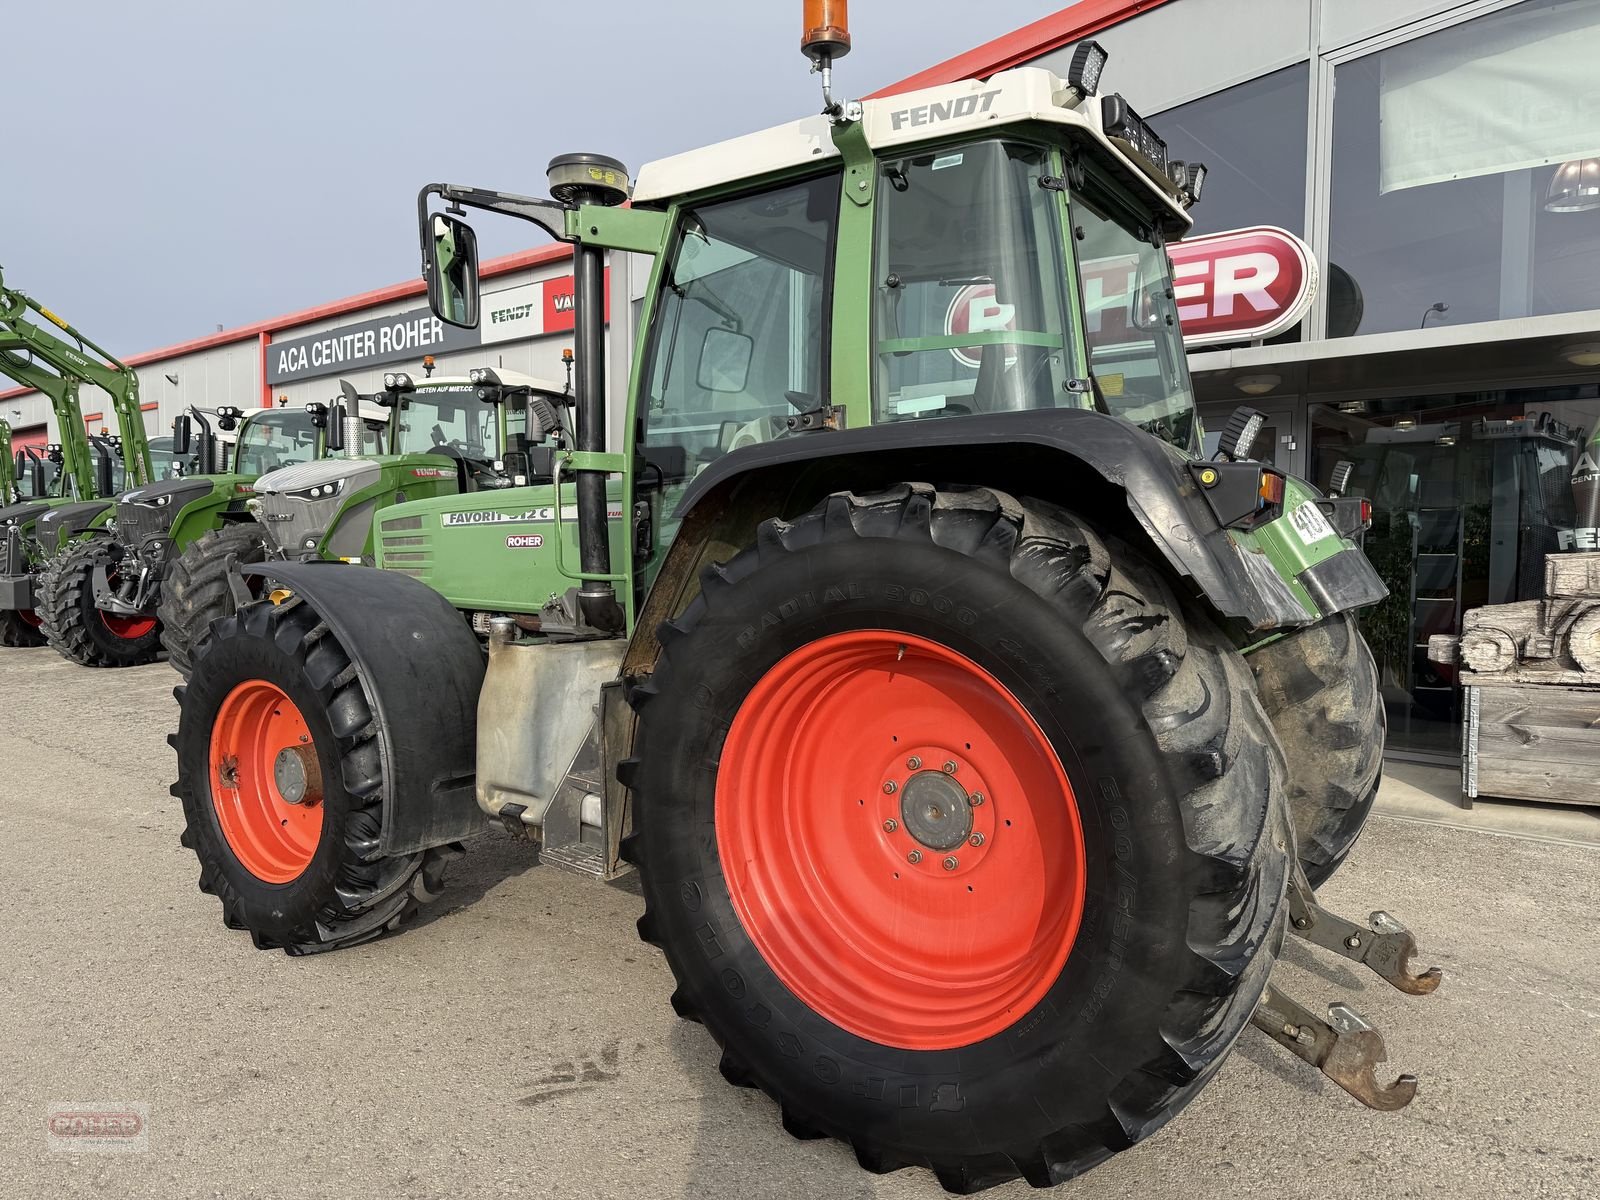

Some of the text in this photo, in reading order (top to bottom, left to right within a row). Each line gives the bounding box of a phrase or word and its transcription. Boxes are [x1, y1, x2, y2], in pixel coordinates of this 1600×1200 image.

[891, 89, 1002, 131] FENDT
[967, 252, 1281, 347] RHER
[491, 303, 533, 324] FENDT
[278, 316, 444, 374] ACA CENTER ROHER
[415, 386, 437, 395] MIETEN
[436, 385, 449, 393] AUF
[415, 467, 437, 476] FENDT
[539, 508, 548, 519] C
[507, 536, 542, 547] ROHER
[1557, 527, 1600, 551] FE
[735, 581, 866, 650] RADIAL
